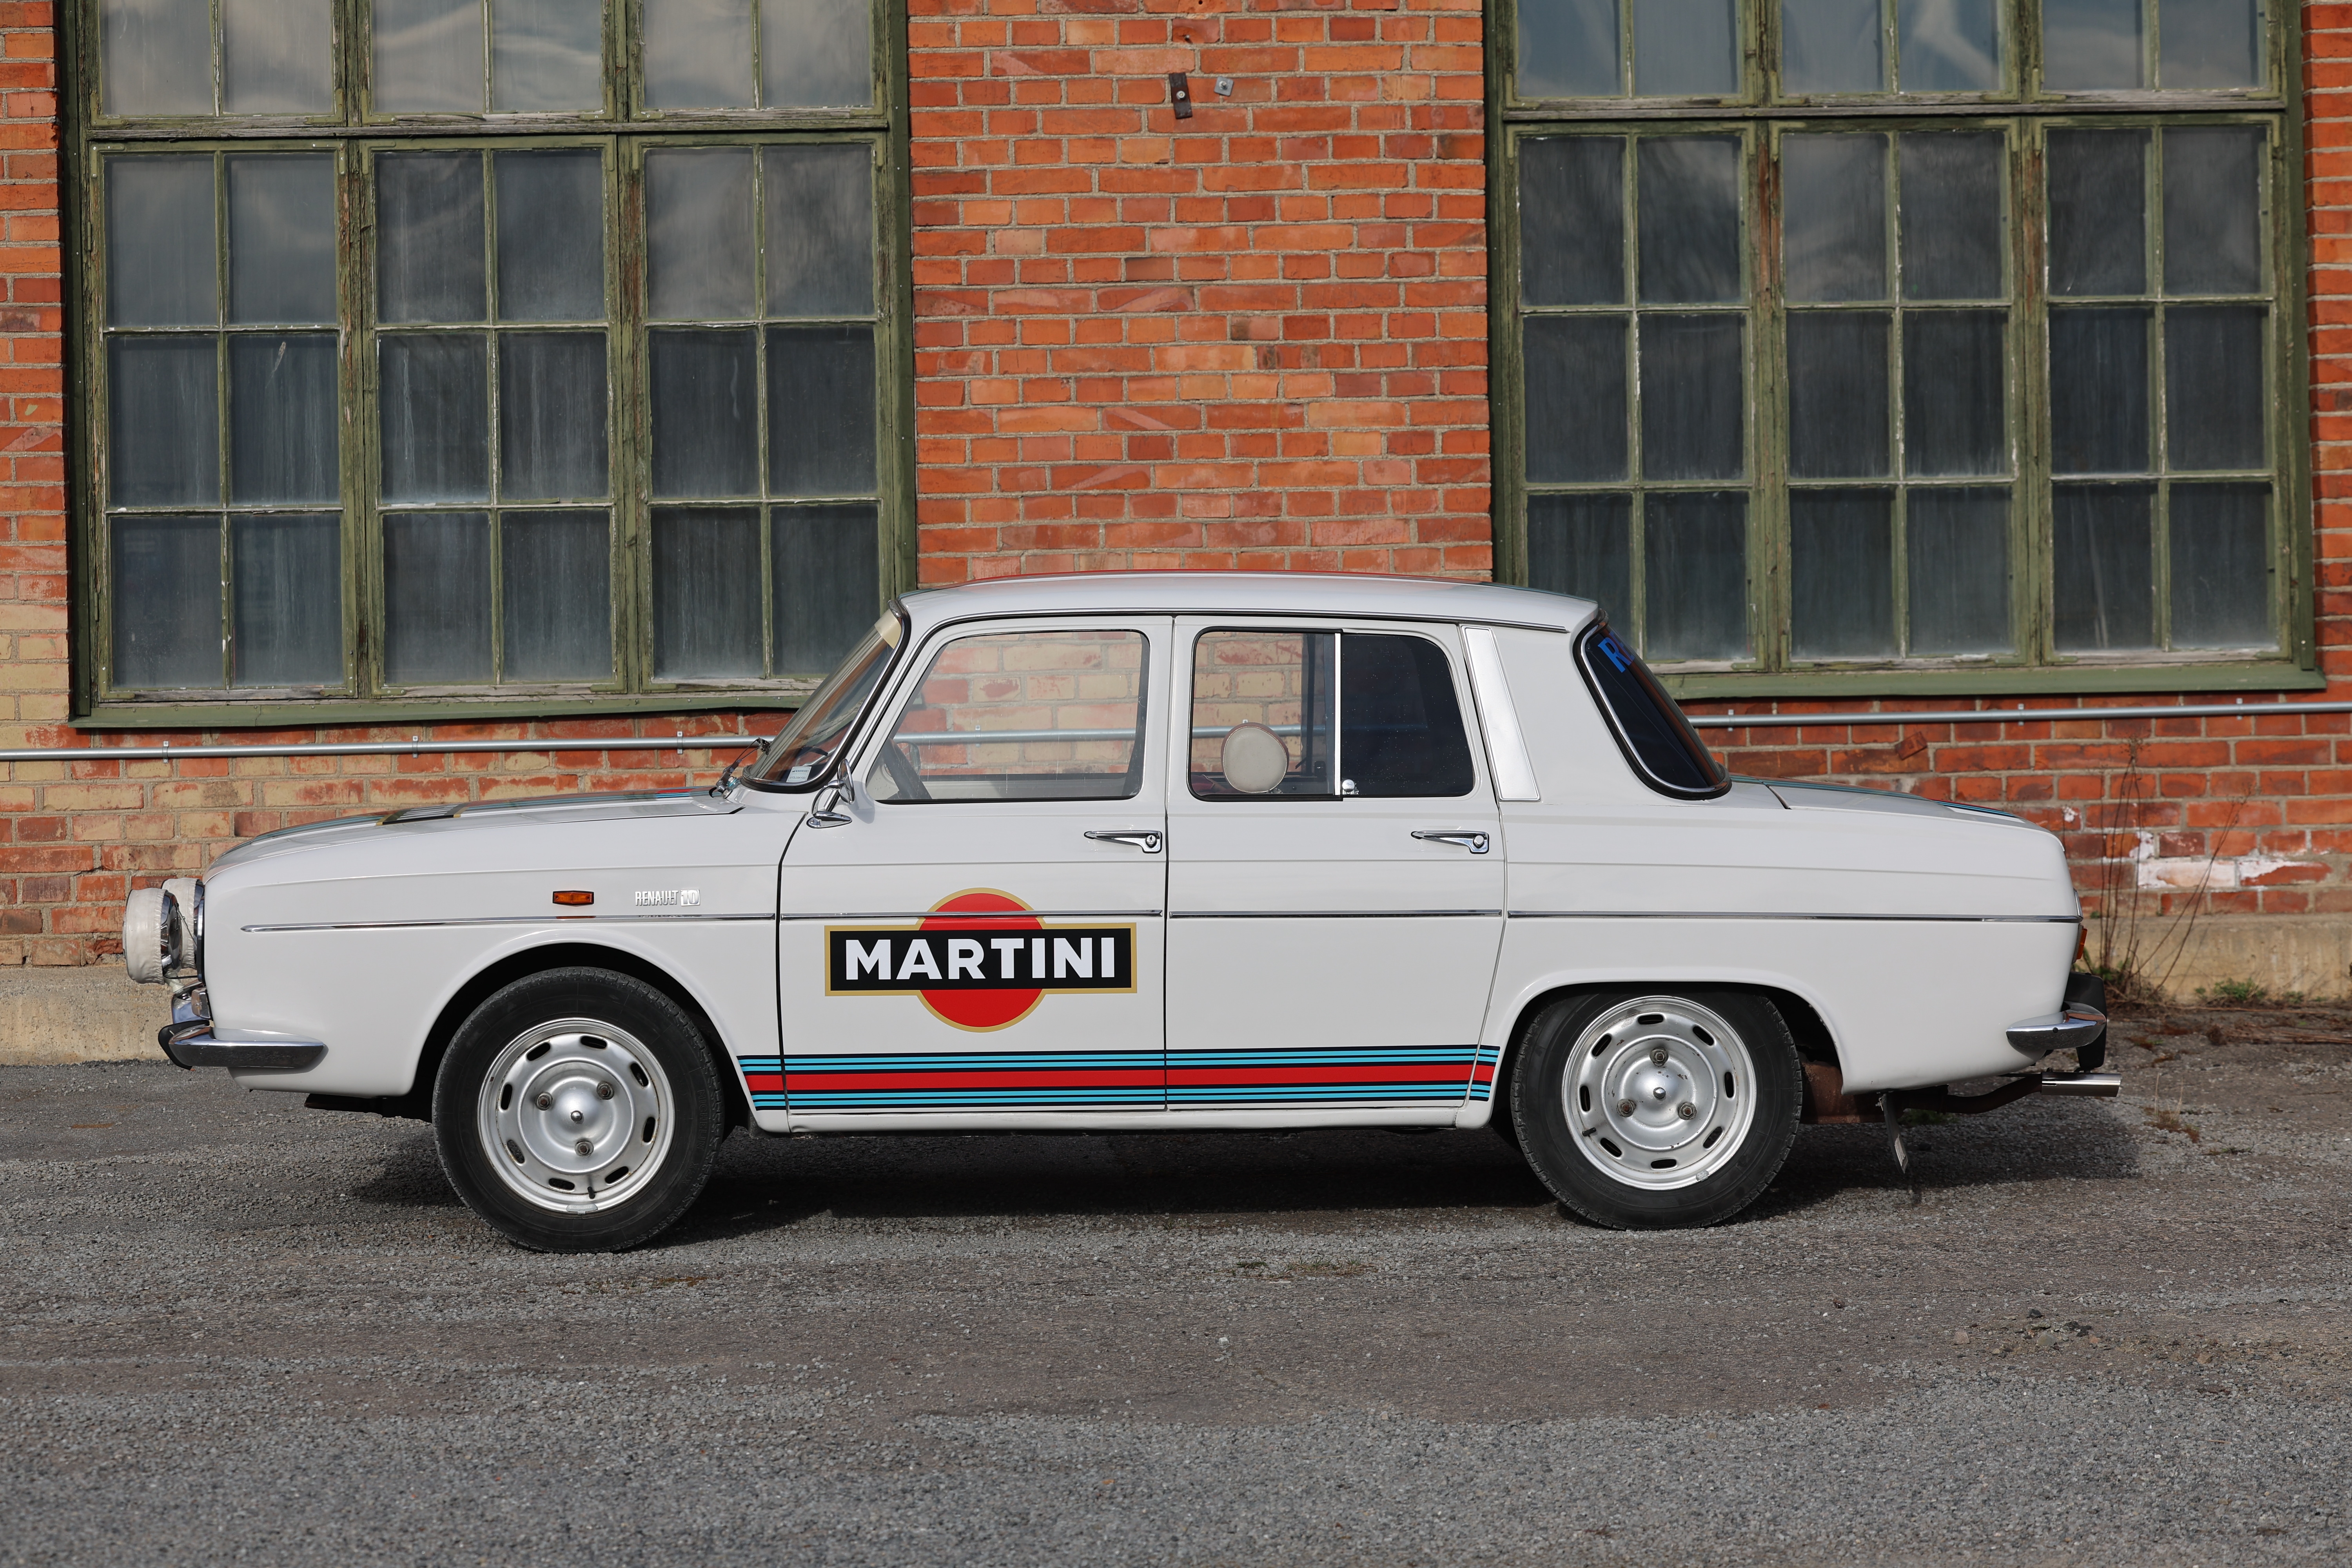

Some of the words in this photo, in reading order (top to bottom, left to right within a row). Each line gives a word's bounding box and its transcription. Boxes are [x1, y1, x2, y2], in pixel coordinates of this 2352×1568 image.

[635, 890, 679, 906] RENAULT
[681, 890, 699, 905] 10
[846, 937, 1115, 980] MARTINI
[697, 1089, 708, 1150] MICHELIN
